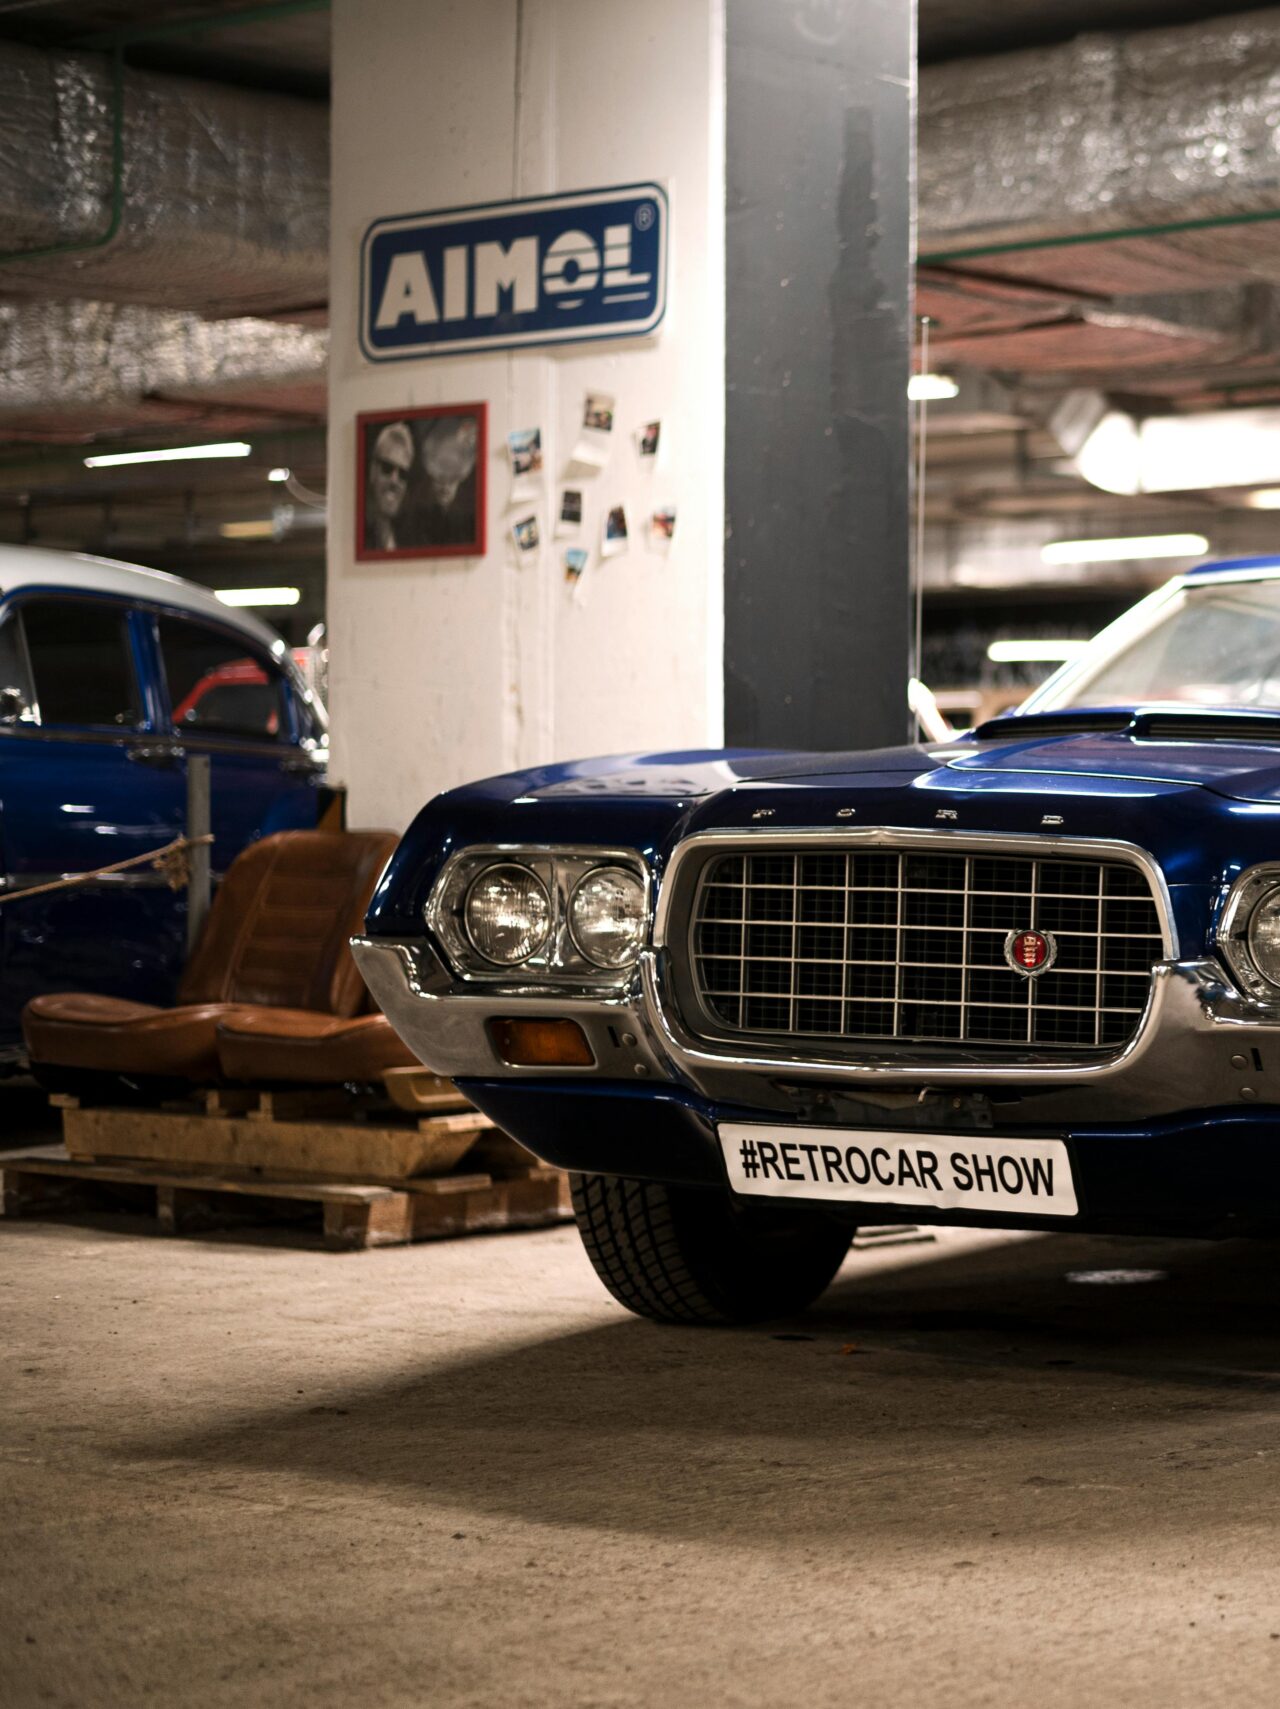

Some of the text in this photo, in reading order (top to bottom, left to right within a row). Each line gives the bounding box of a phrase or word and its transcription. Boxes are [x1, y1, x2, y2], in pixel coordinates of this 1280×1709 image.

[374, 224, 651, 331] AIMOL
[752, 808, 1064, 826] FORD
[739, 1139, 1054, 1197] #RETROCAR SHOW
